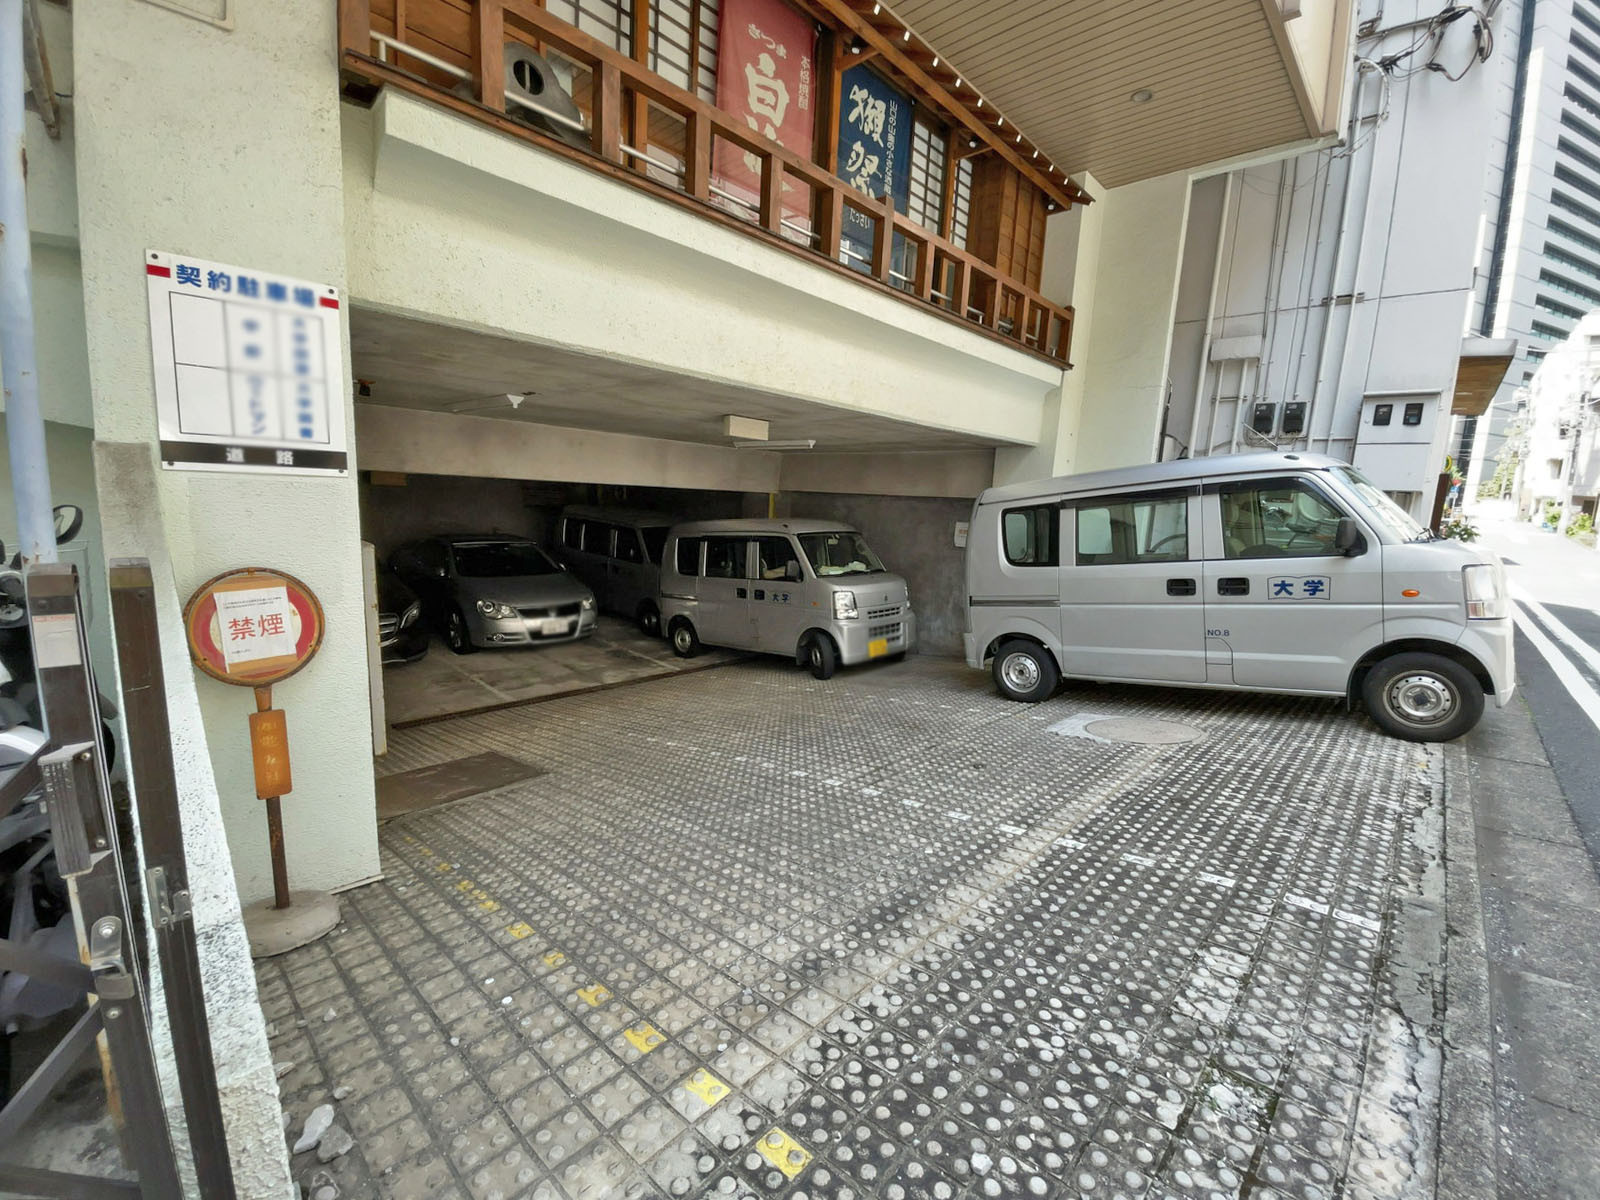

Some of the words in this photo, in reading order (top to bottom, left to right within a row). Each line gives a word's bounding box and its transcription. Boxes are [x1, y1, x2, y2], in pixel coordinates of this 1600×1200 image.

[176, 264, 316, 308] 契約駐車場
[1273, 579, 1325, 596] 大学
[228, 613, 286, 641] 禁煙
[1207, 629, 1230, 637] NO.8
